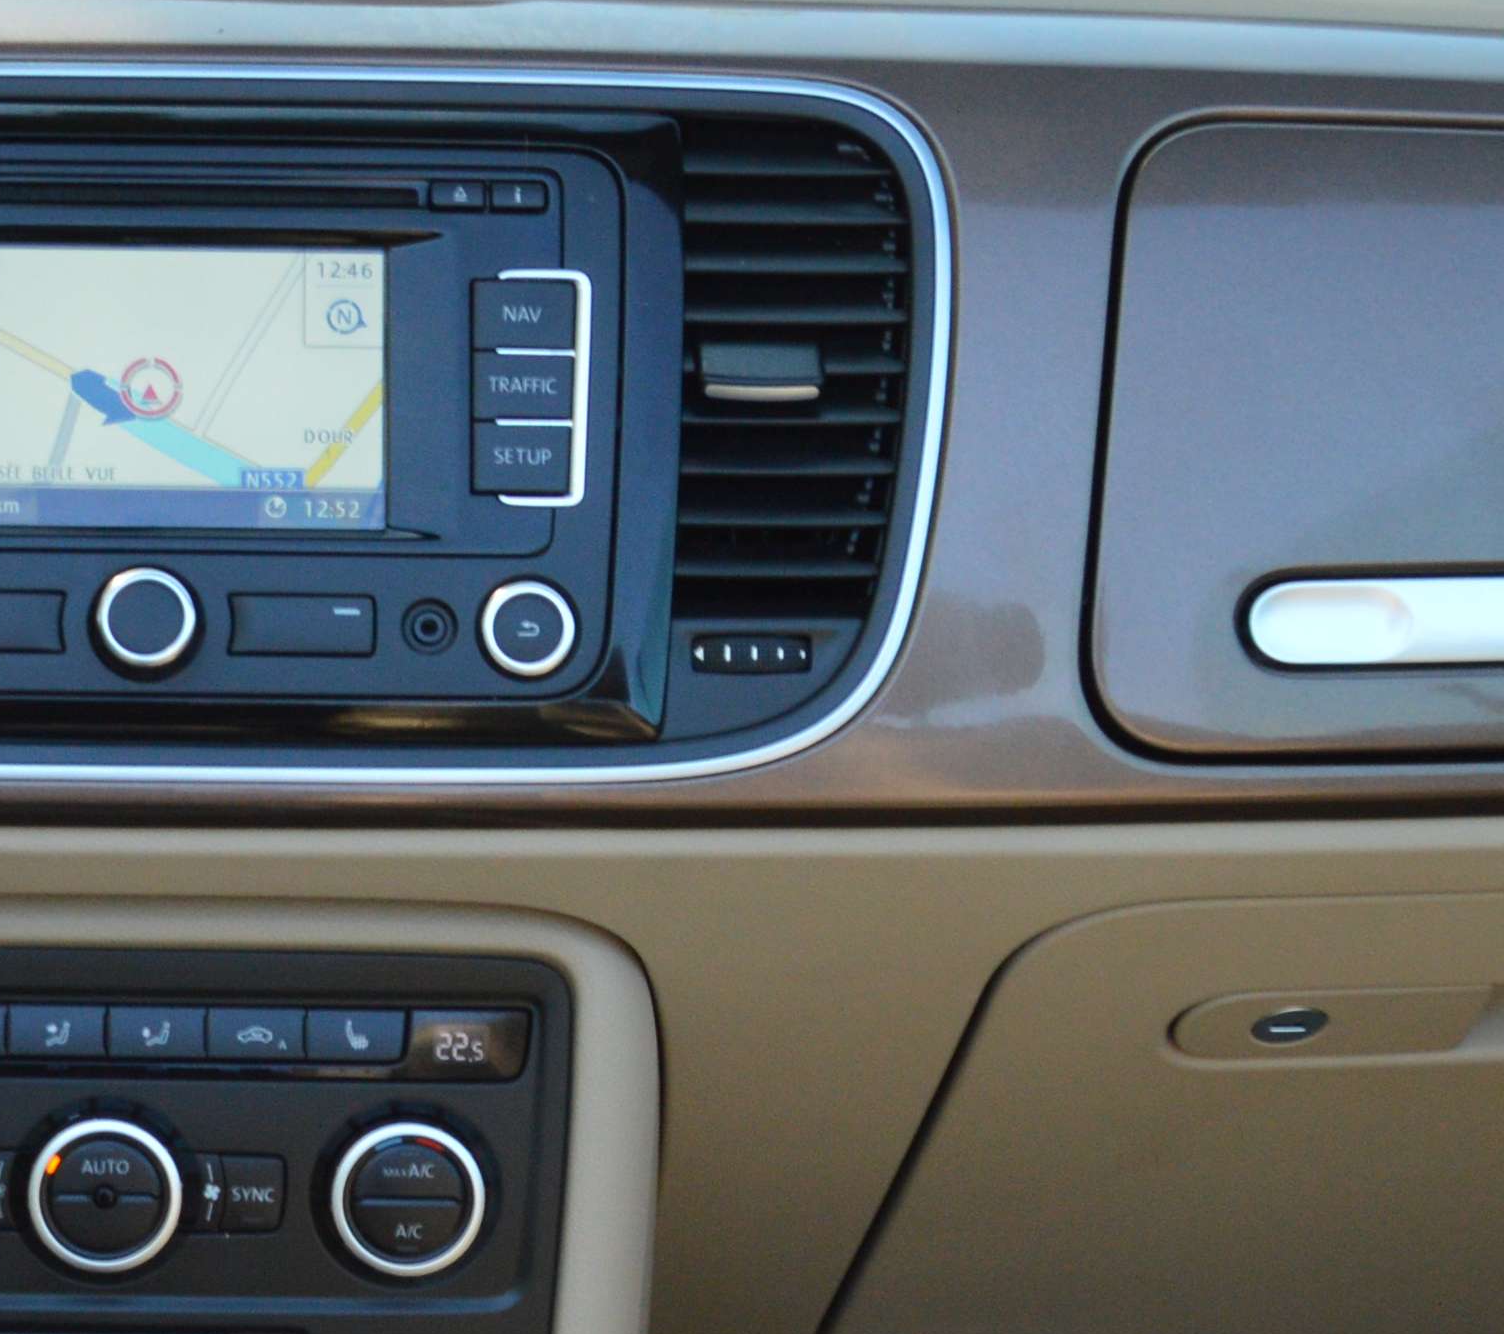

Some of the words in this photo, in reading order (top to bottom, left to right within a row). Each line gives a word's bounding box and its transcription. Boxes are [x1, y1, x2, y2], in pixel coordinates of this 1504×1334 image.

[317, 261, 373, 279] 12:46
[502, 305, 542, 323] NAV
[489, 375, 558, 395] TRAFFIC
[303, 429, 353, 444] DOUR
[494, 448, 552, 465] SETUP
[86, 468, 115, 481] VUE
[245, 471, 297, 489] N552
[304, 500, 360, 518] 12:52
[81, 1159, 129, 1175] AUTO
[409, 1163, 434, 1178] A/C
[232, 1188, 275, 1203] SYNC
[396, 1223, 422, 1240] A/C
